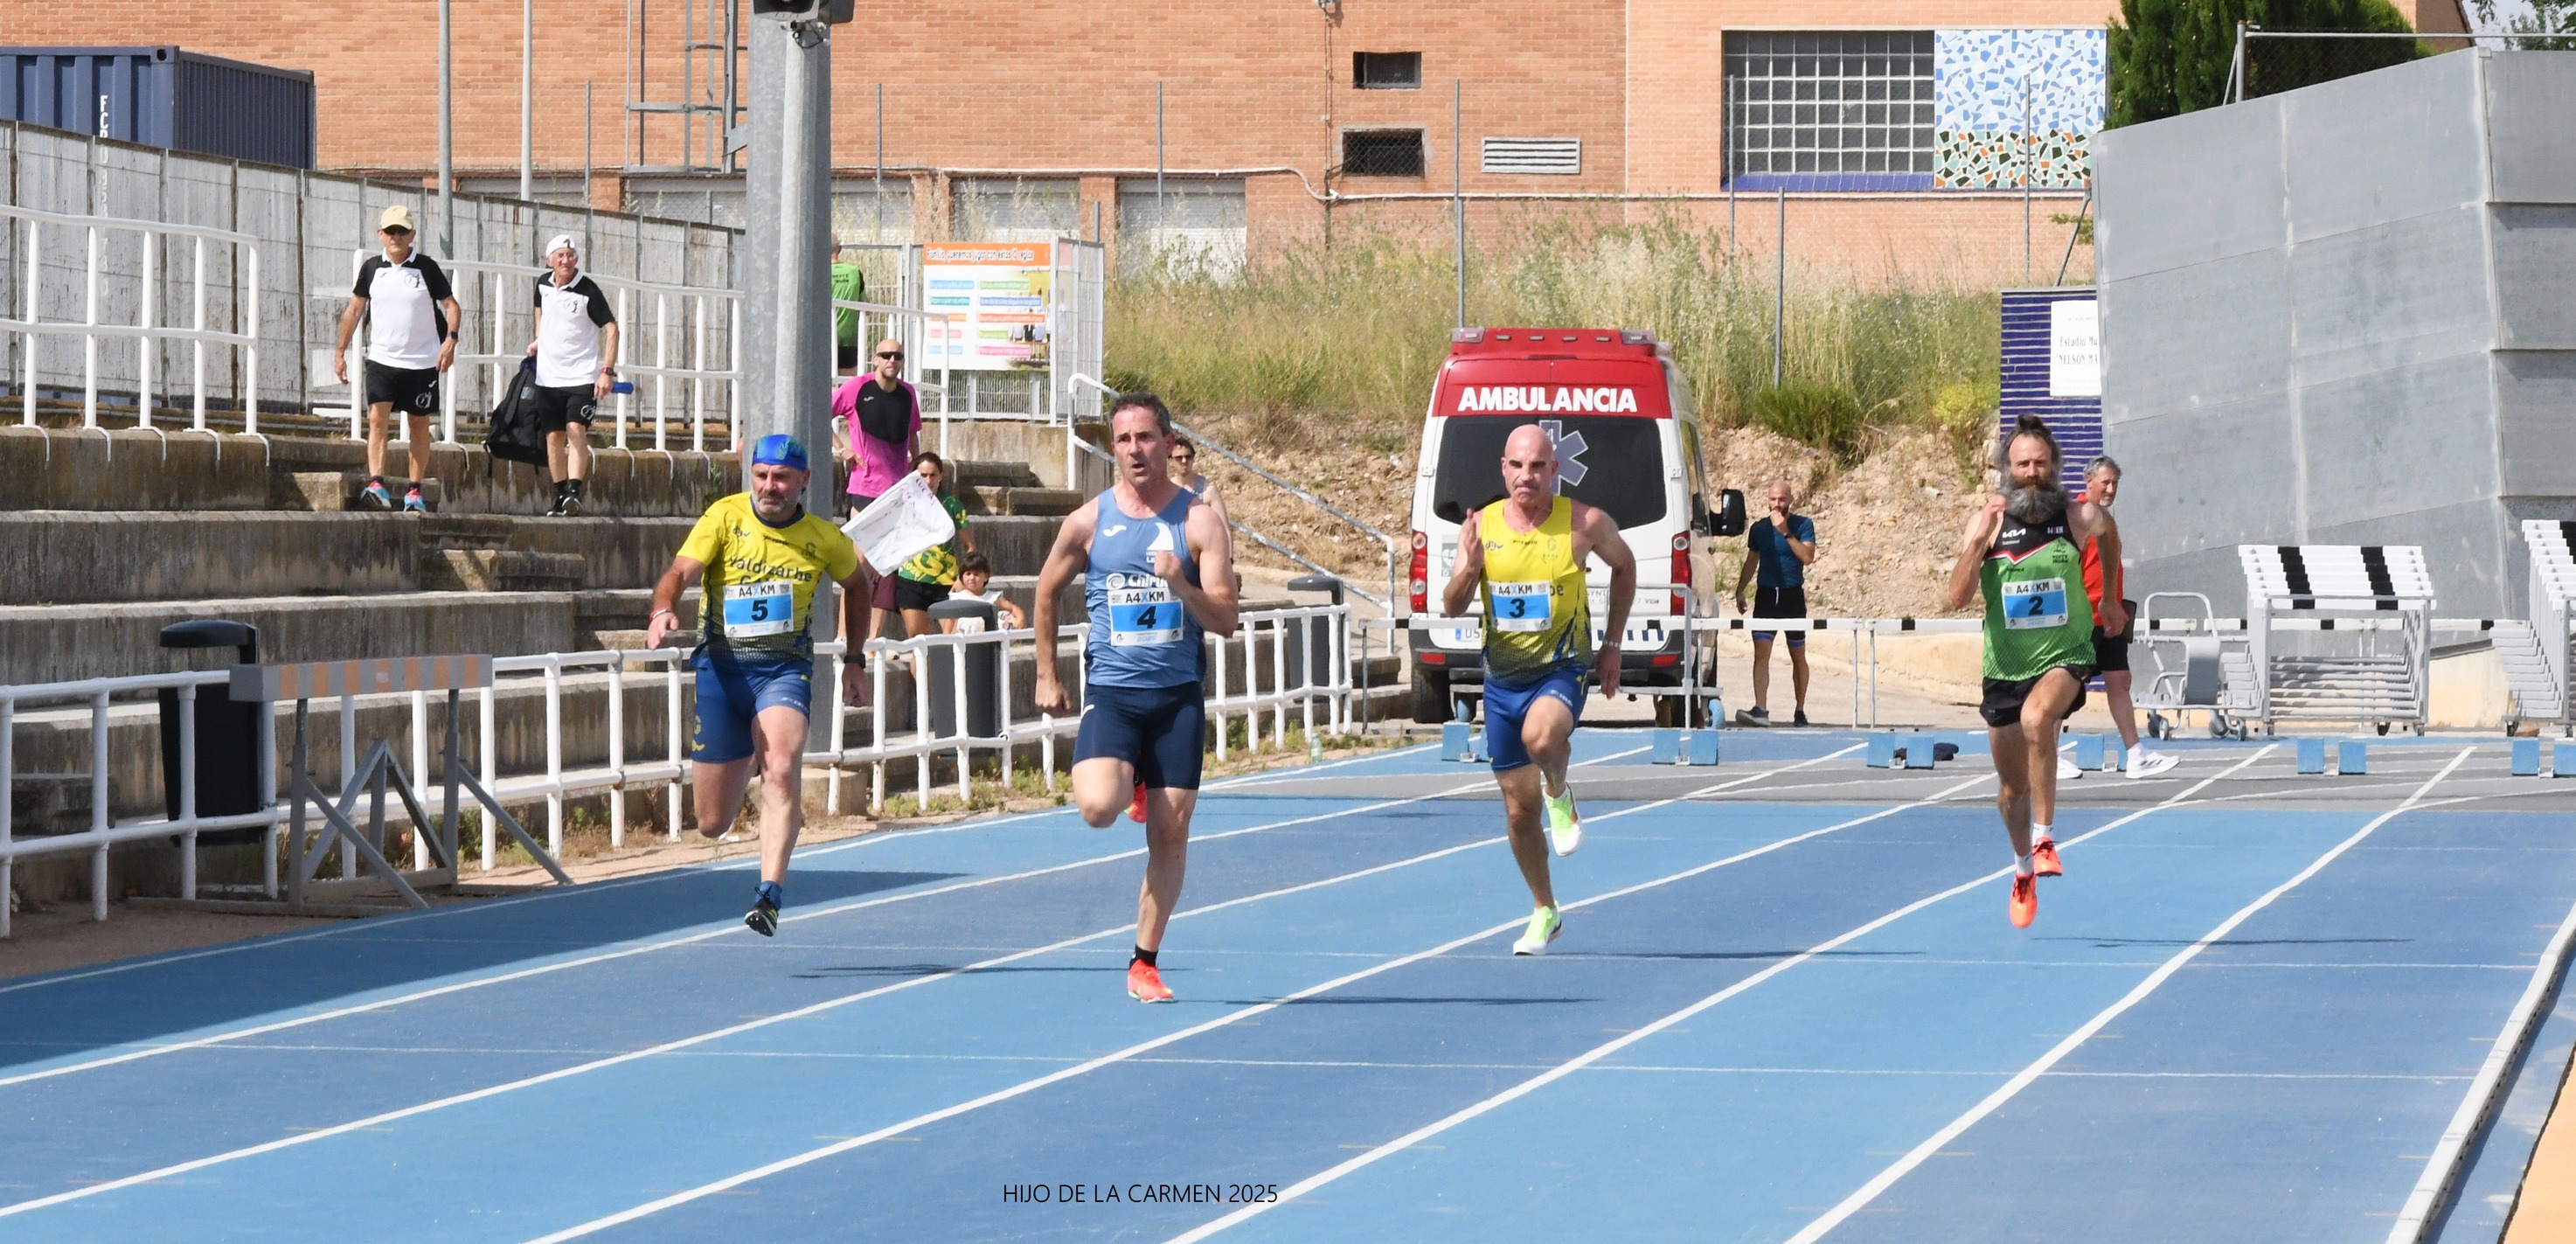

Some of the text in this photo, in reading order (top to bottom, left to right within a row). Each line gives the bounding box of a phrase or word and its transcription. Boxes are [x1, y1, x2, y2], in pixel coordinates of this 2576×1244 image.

[2060, 336, 2098, 347] Estadio Mu
[2088, 354, 2098, 365] MA
[1458, 386, 1637, 413] AMBULANCIA
[739, 584, 775, 597] A4XKM
[1498, 585, 1532, 594] A4XKM
[2017, 582, 2050, 594] A4XKM
[1126, 591, 1164, 603] A4XKM
[751, 599, 768, 621] 5
[1509, 598, 1525, 618] 3
[2028, 596, 2044, 616] 2
[1136, 605, 1156, 629] 4
